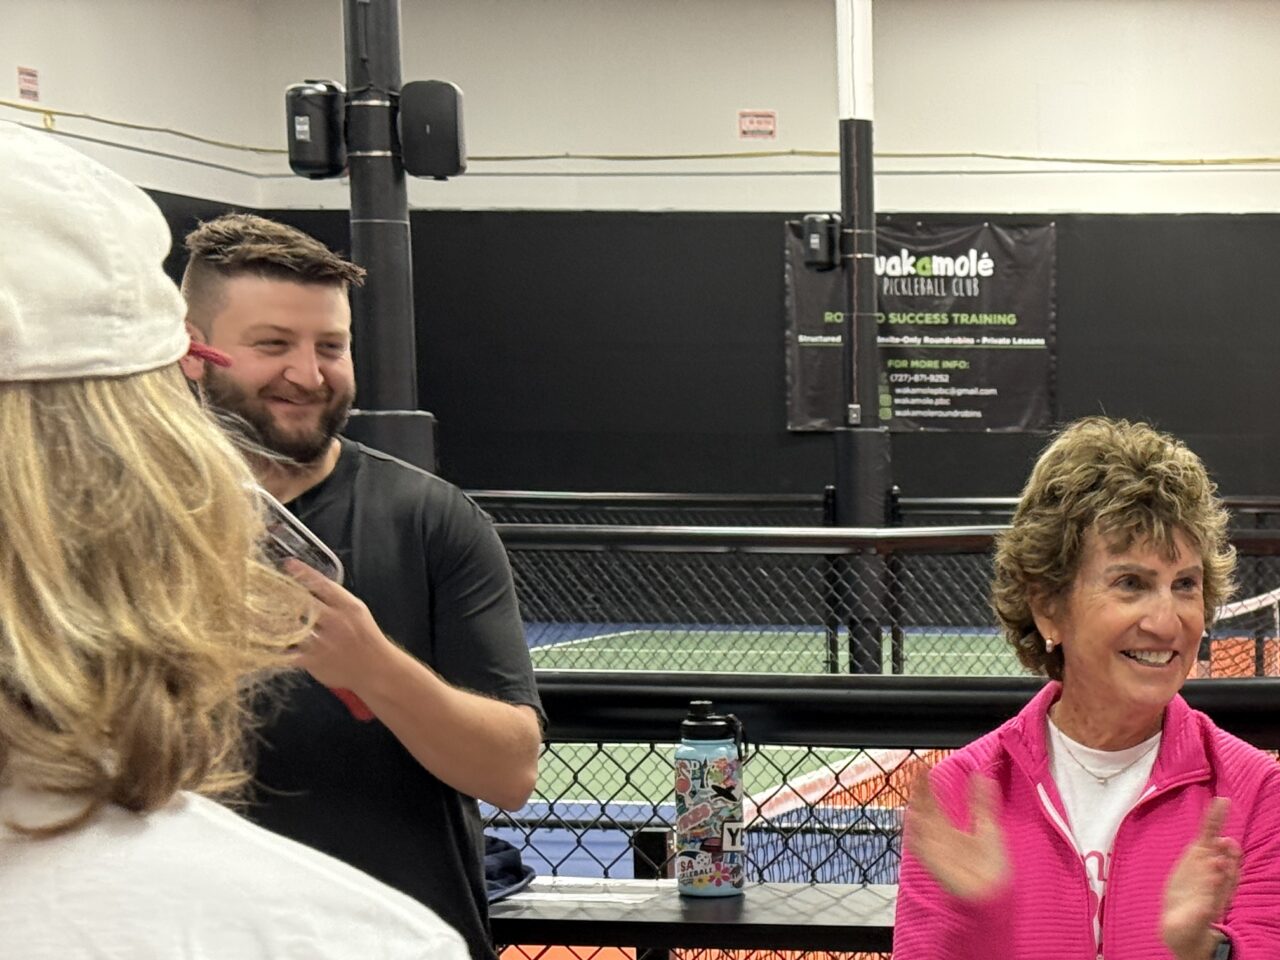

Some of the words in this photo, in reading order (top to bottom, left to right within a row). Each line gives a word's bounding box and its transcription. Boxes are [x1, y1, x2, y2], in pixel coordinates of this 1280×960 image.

[883, 277, 946, 296] PICKLEBALL
[952, 277, 980, 296] CLUB
[888, 312, 949, 324] SUCCESS
[952, 313, 1017, 325] TRAINING
[887, 360, 908, 368] FOR
[910, 360, 939, 369] MORE
